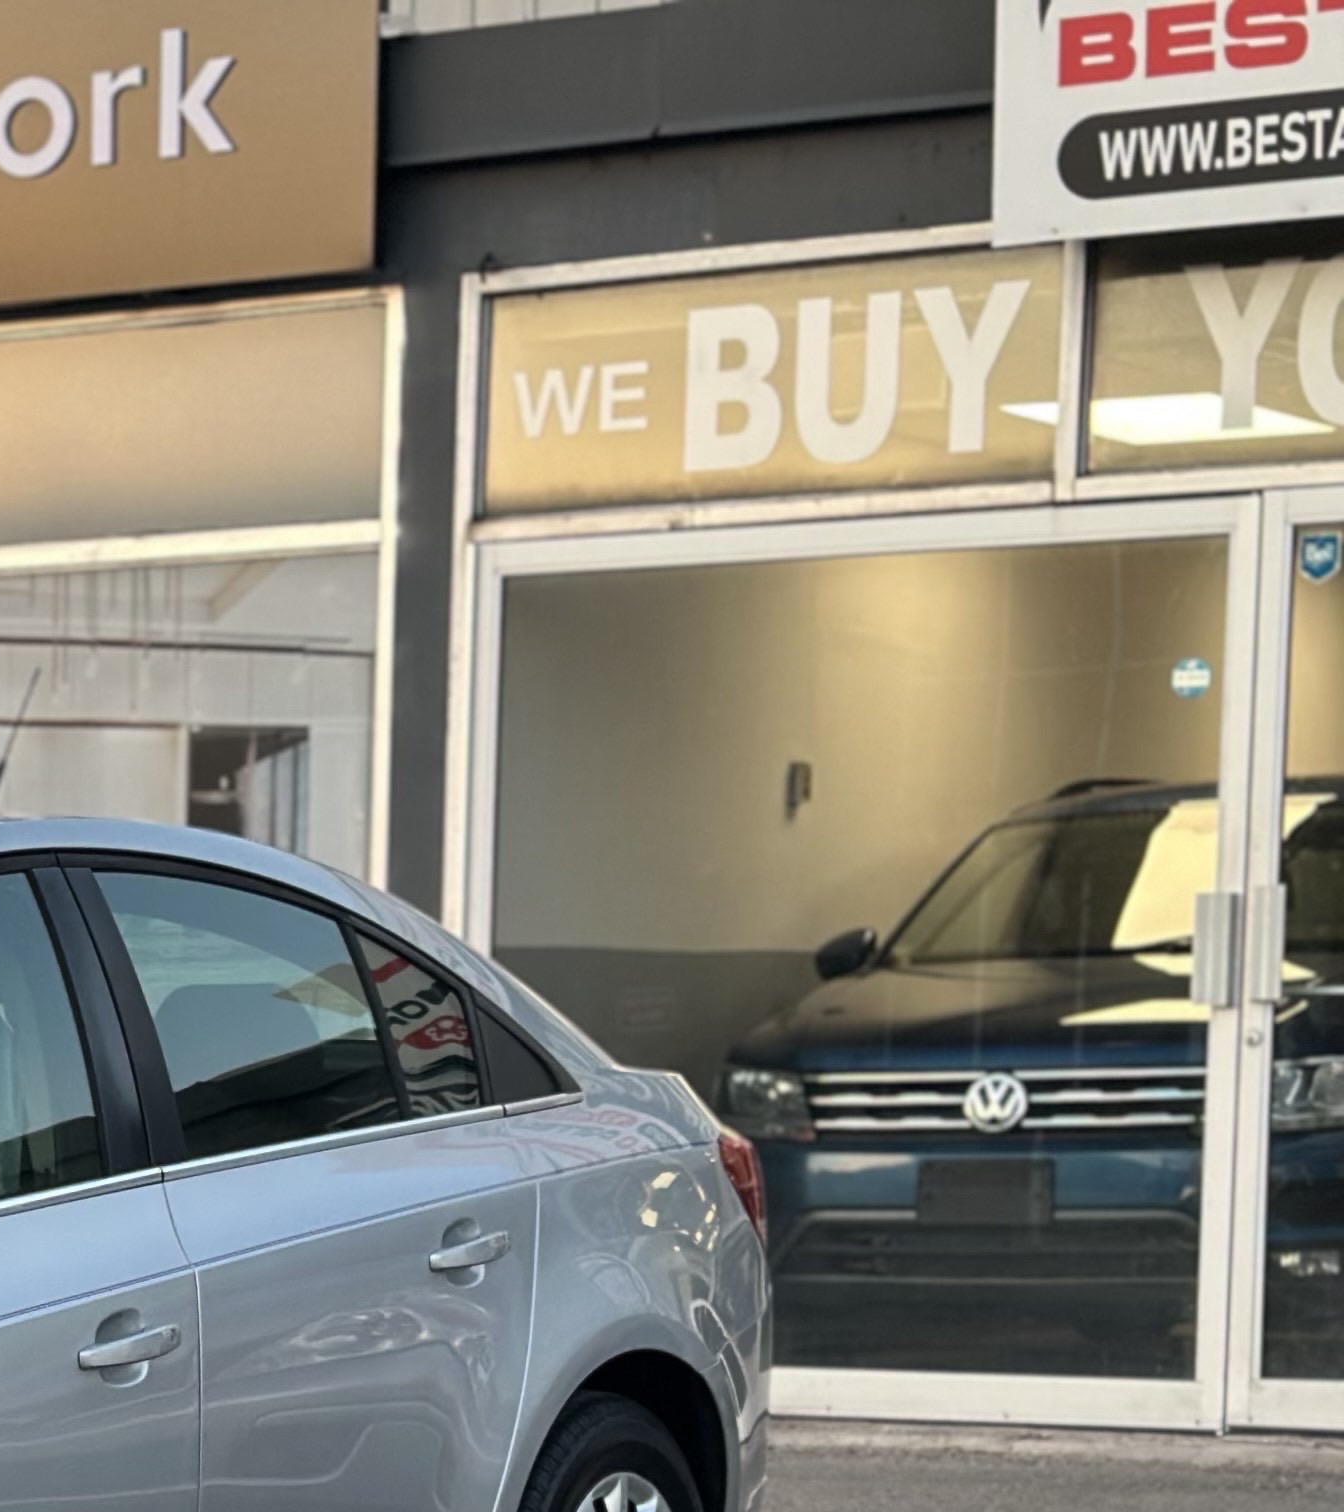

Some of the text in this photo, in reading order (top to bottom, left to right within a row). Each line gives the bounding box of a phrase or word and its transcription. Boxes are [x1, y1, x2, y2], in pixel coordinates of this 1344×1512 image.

[1058, 0, 1344, 87] BES
[513, 361, 649, 439] WE
[683, 279, 1031, 472] BUY
